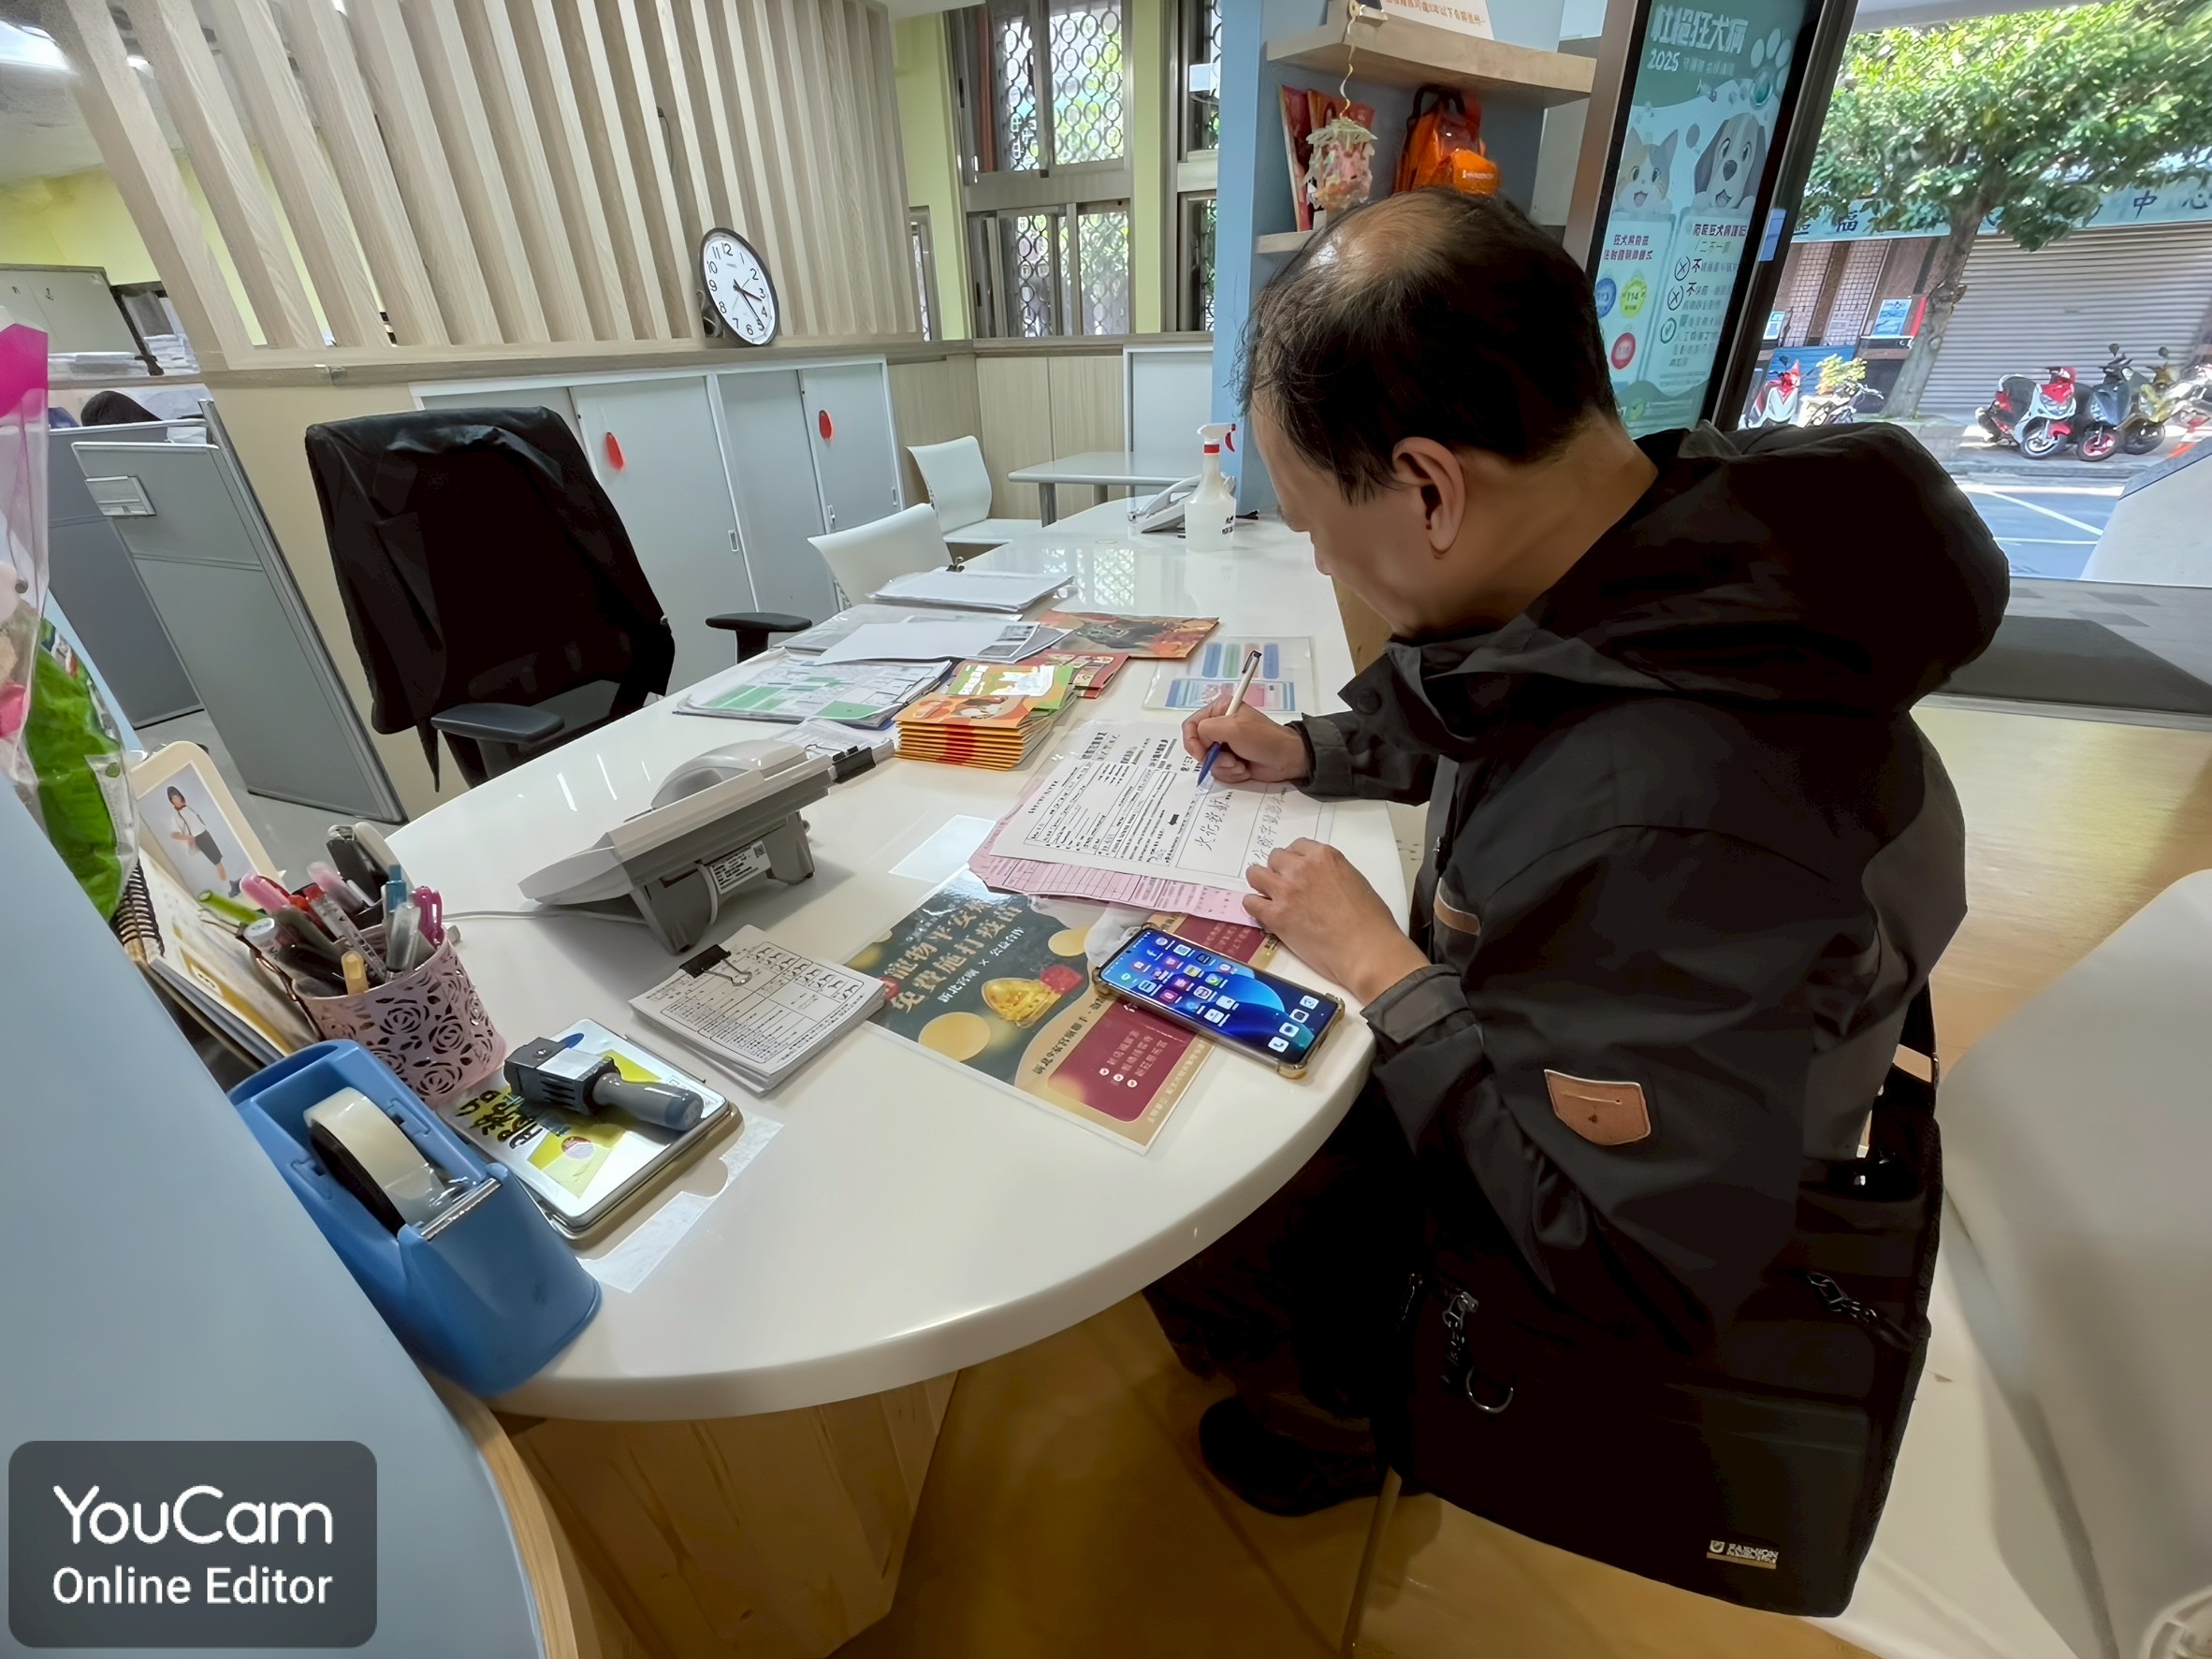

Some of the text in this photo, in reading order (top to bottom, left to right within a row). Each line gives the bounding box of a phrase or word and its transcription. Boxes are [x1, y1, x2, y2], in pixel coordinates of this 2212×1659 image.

[1647, 48, 1681, 72] 2025
[711, 246, 721, 259] 11
[721, 242, 734, 256] 12
[706, 261, 718, 274] 10
[749, 268, 759, 281] 2
[708, 280, 718, 292] 9
[759, 287, 766, 298] 3
[719, 301, 727, 313] 8
[761, 306, 768, 317] 4
[732, 318, 739, 329] 7
[746, 324, 754, 336] 6
